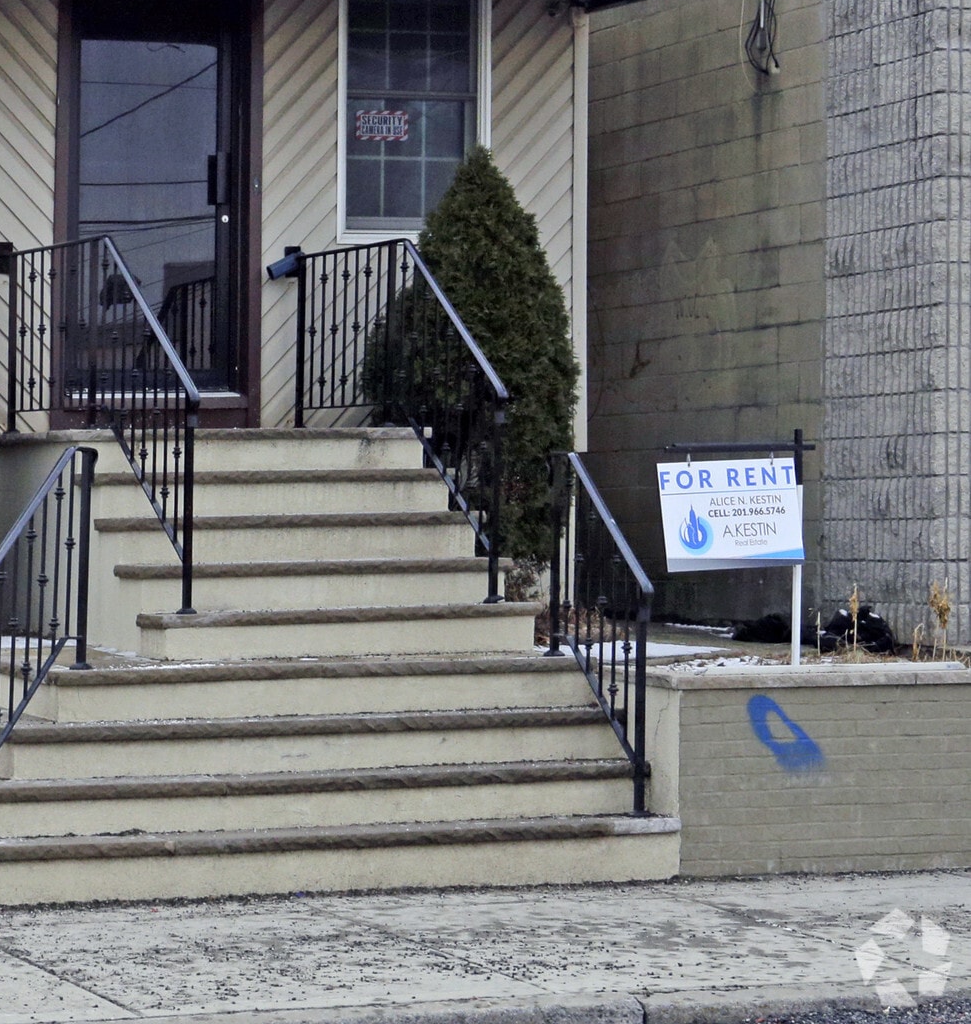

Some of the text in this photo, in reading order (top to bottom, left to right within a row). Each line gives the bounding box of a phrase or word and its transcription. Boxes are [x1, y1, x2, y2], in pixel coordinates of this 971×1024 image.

[361, 115, 403, 126] SECURITY
[361, 125, 384, 135] CAMERA
[392, 126, 403, 136] USE
[659, 466, 793, 490] FOR RENT
[709, 494, 782, 506] ALICE N. KESTIN
[707, 506, 786, 518] CELL: 201.966.5746
[750, 538, 768, 546] Estate
